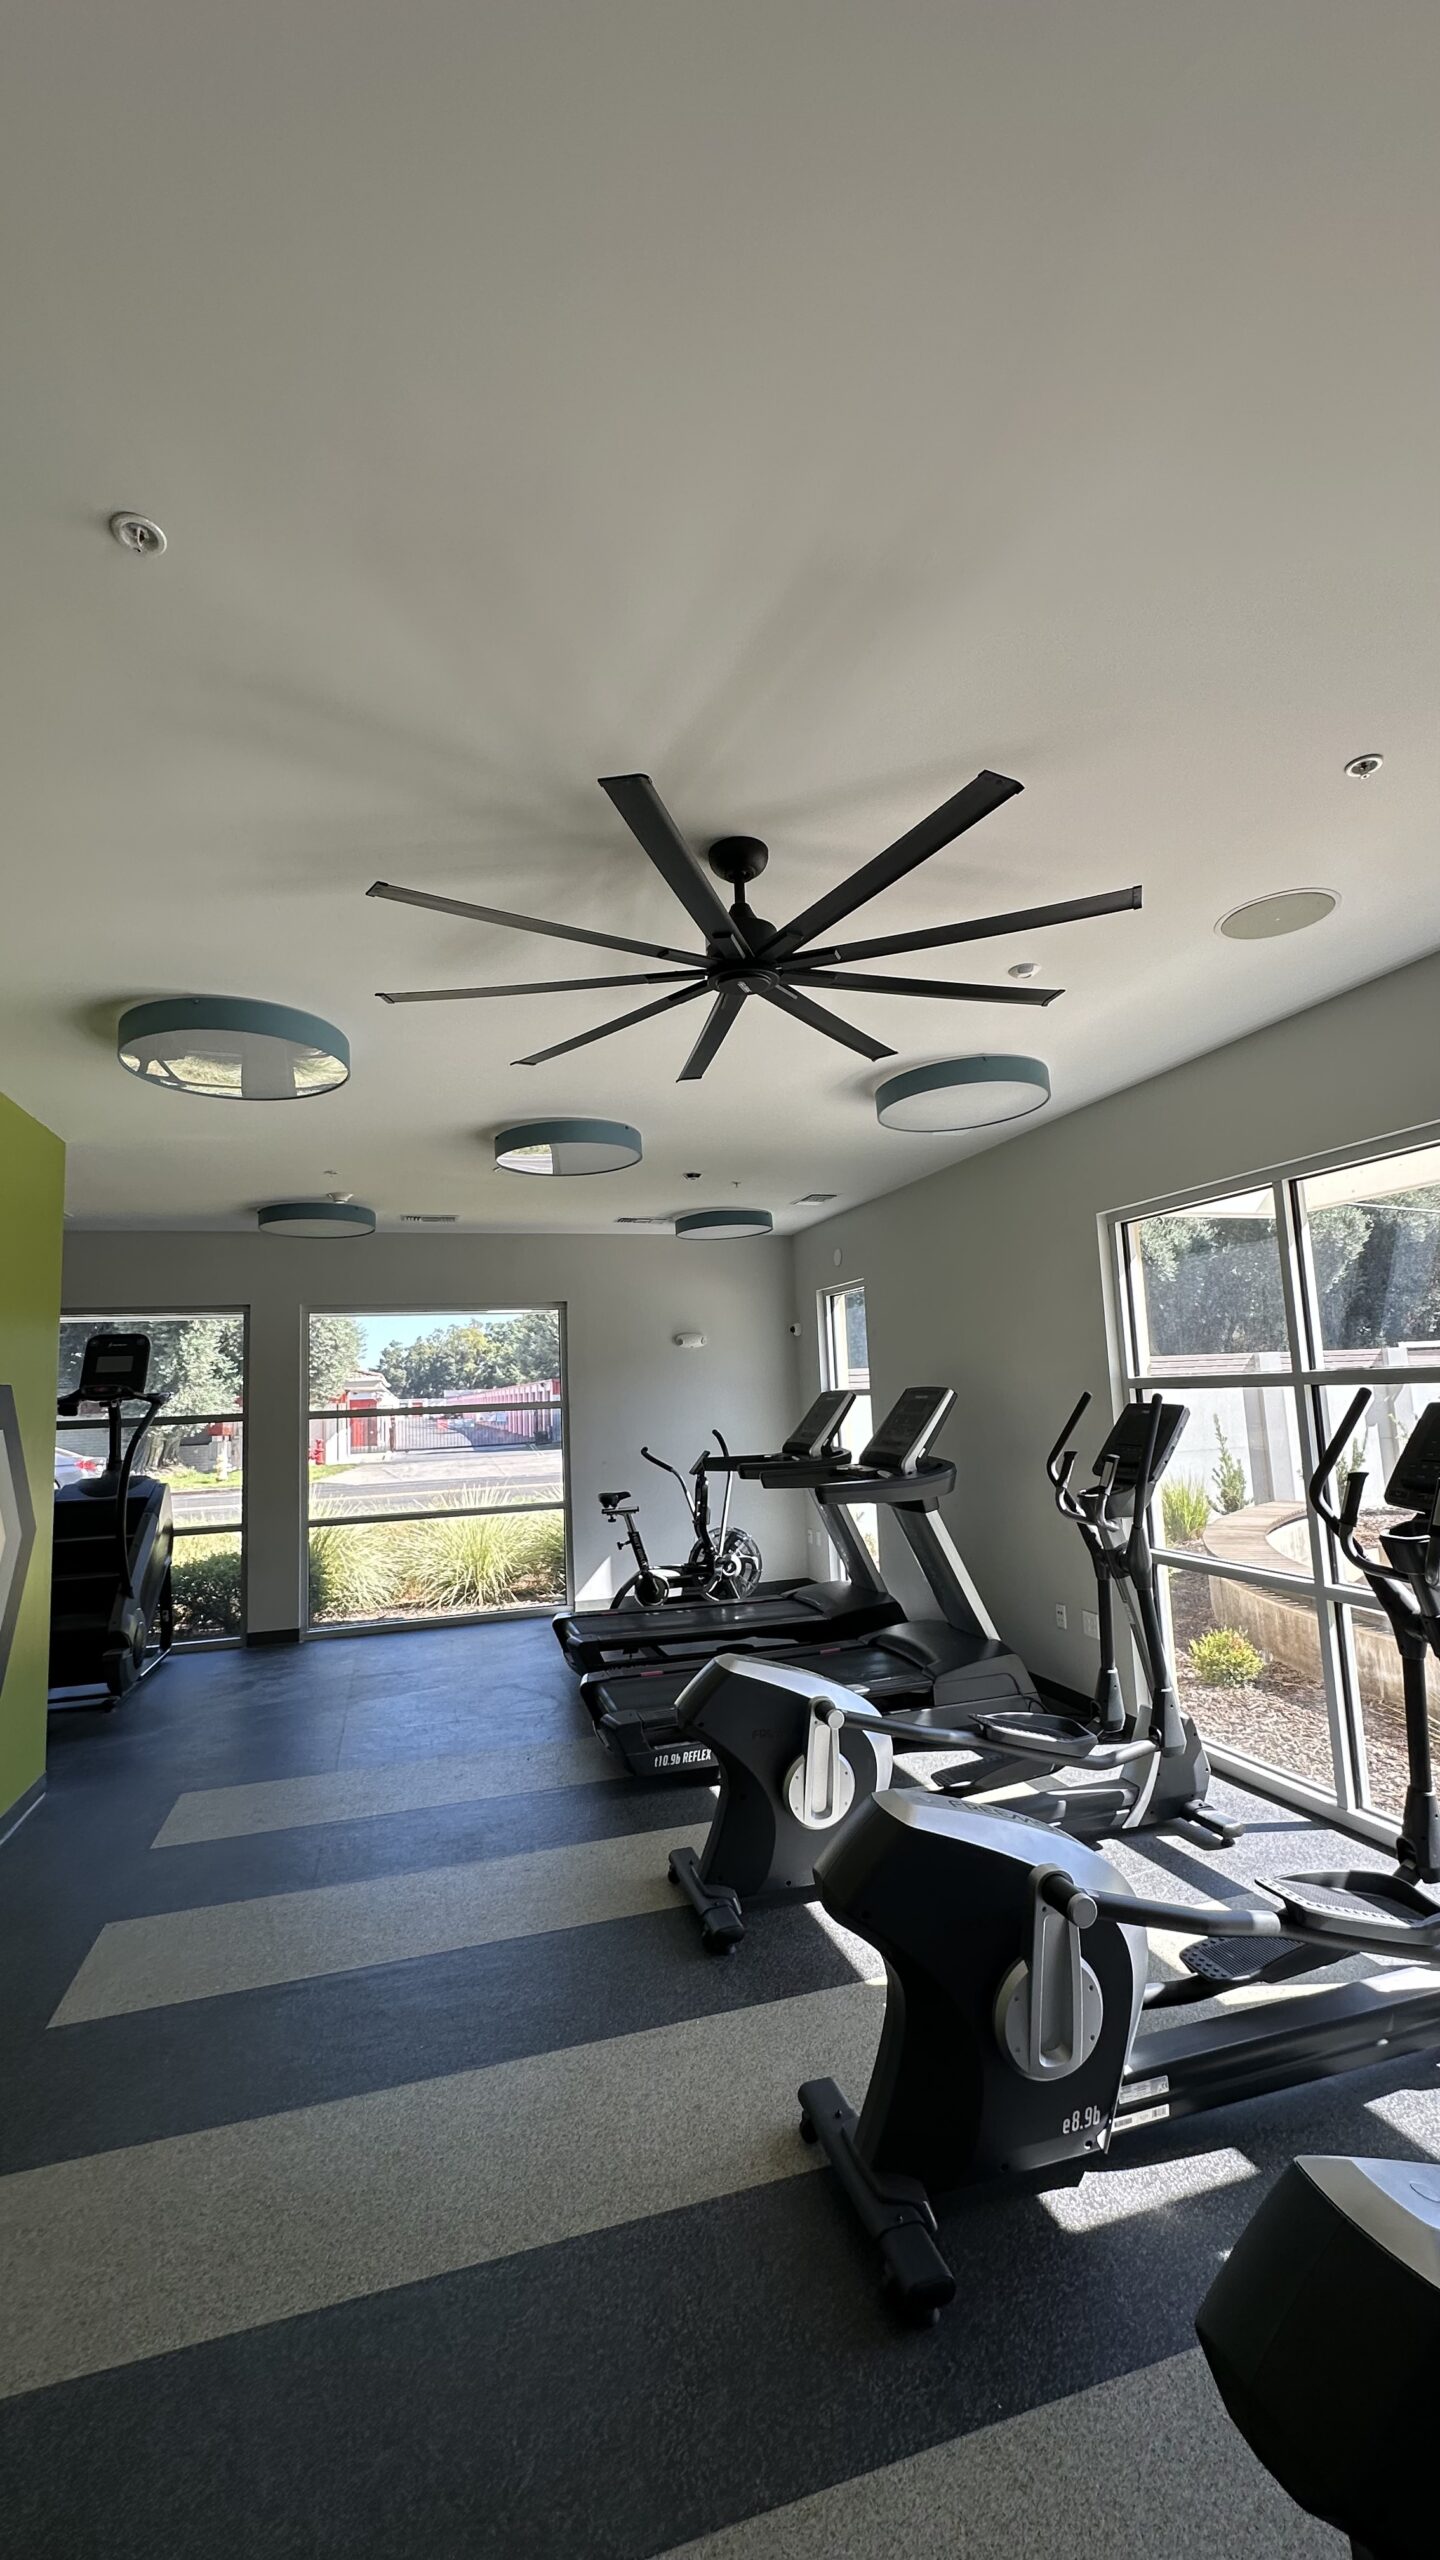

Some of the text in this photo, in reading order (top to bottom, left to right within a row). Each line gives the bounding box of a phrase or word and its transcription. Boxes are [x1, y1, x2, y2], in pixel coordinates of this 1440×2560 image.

[654, 1748, 712, 1768] t10.9b REFLEX
[1062, 2105, 1101, 2134] e8.9b
